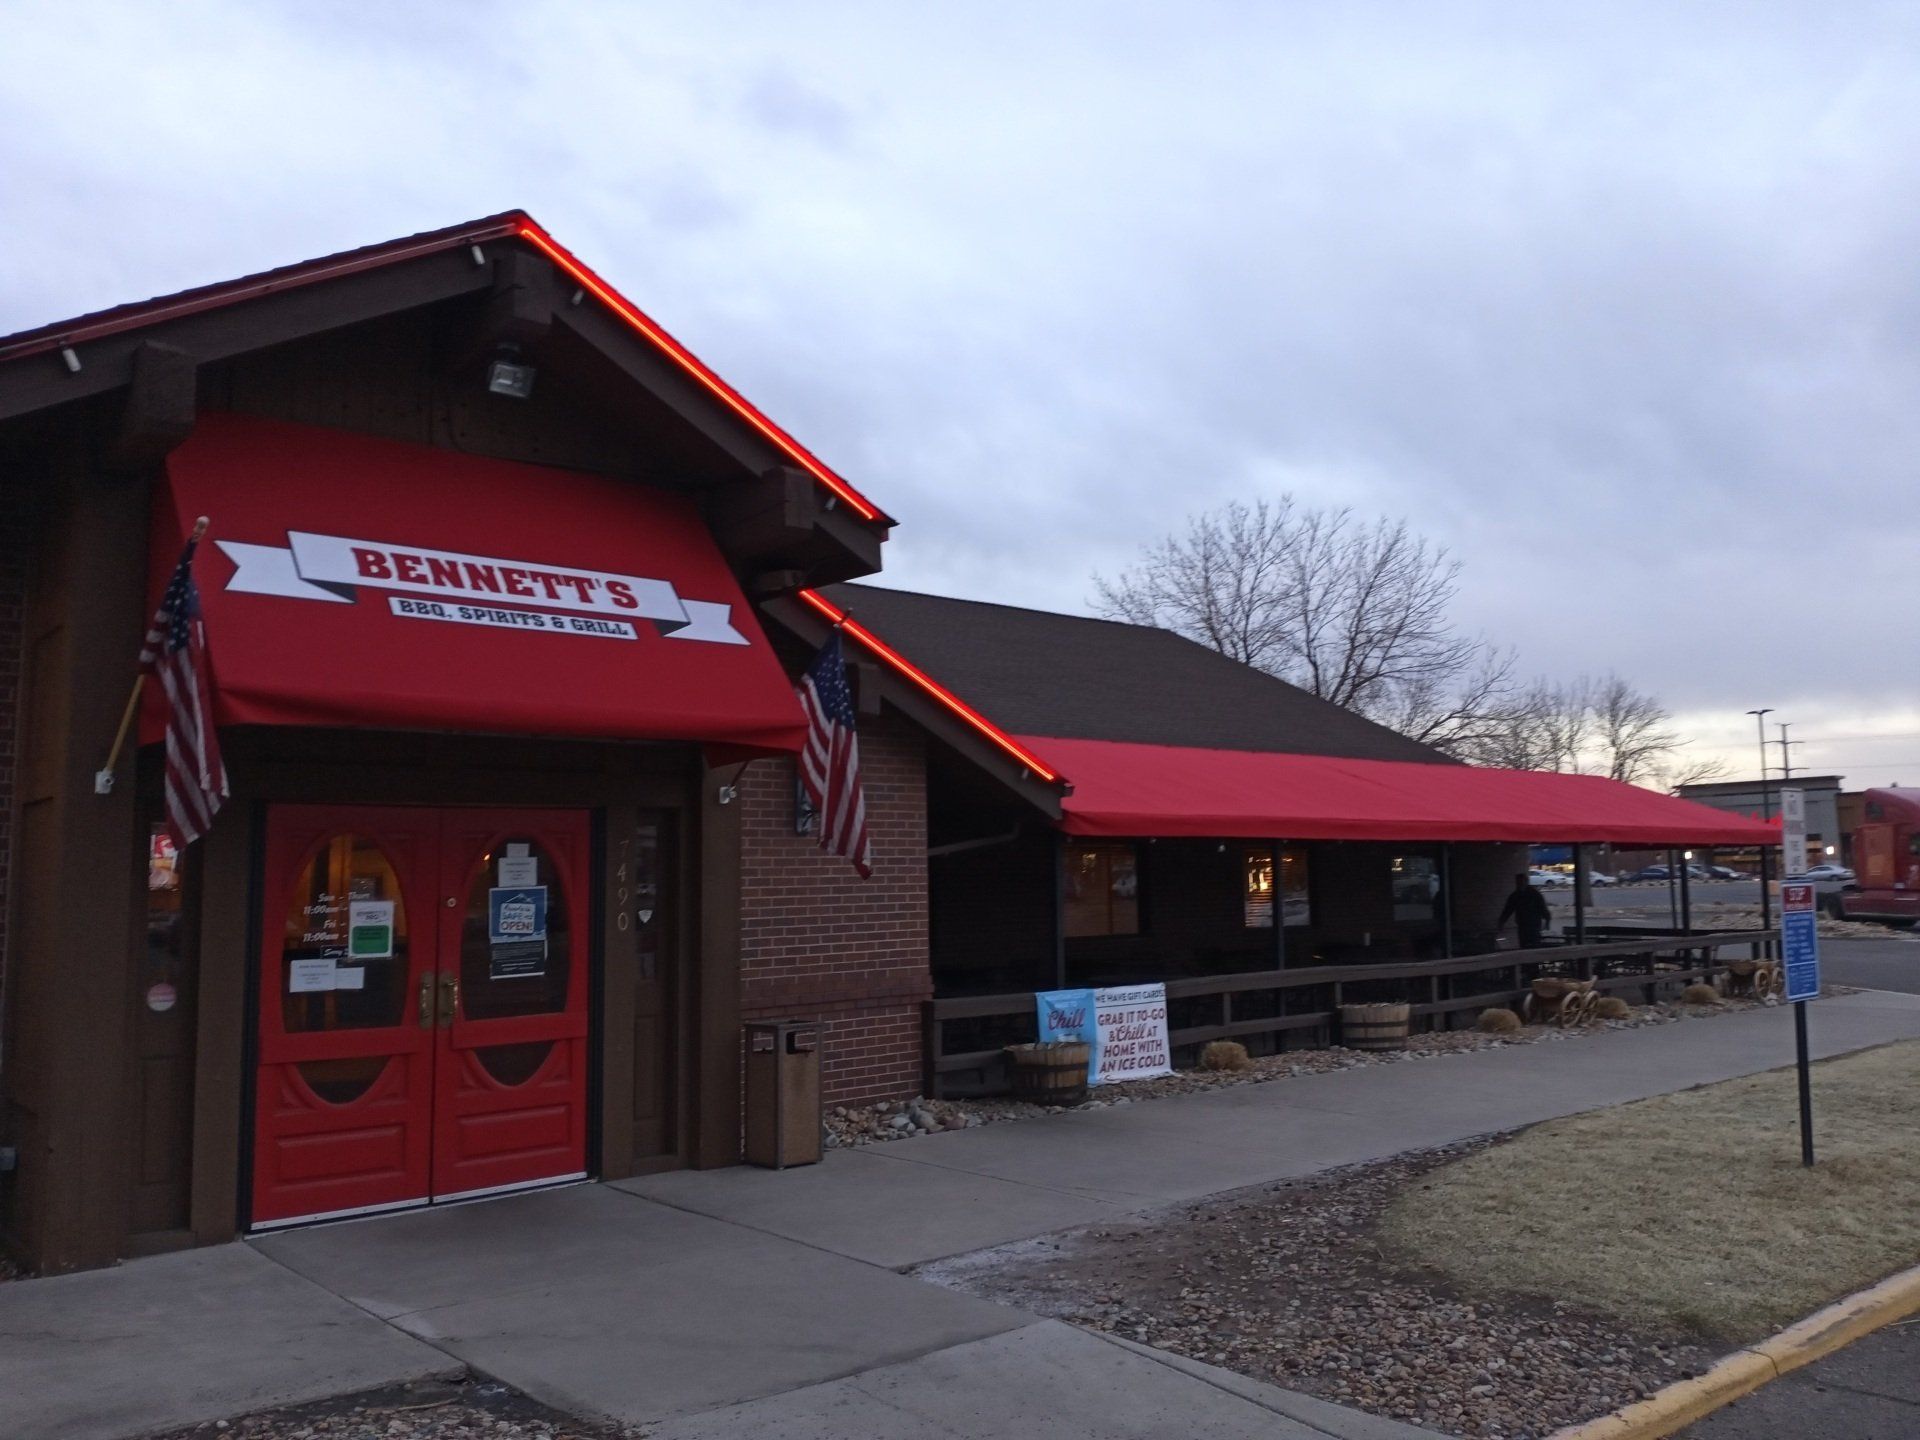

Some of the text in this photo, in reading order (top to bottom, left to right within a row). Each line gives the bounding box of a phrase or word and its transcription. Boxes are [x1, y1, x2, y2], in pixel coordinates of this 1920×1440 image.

[351, 547, 639, 609] BENNETT'S
[399, 600, 629, 636] BBQ, SPIRITS & GRILL
[1048, 1008, 1086, 1031] Chill
[1097, 1007, 1165, 1026] GRAB IT TO-GO
[1116, 1023, 1146, 1042] Chill
[1146, 1025, 1158, 1038] AT
[1104, 1039, 1163, 1058] HOME WITH
[1100, 1054, 1166, 1074] AN ICE COLD
